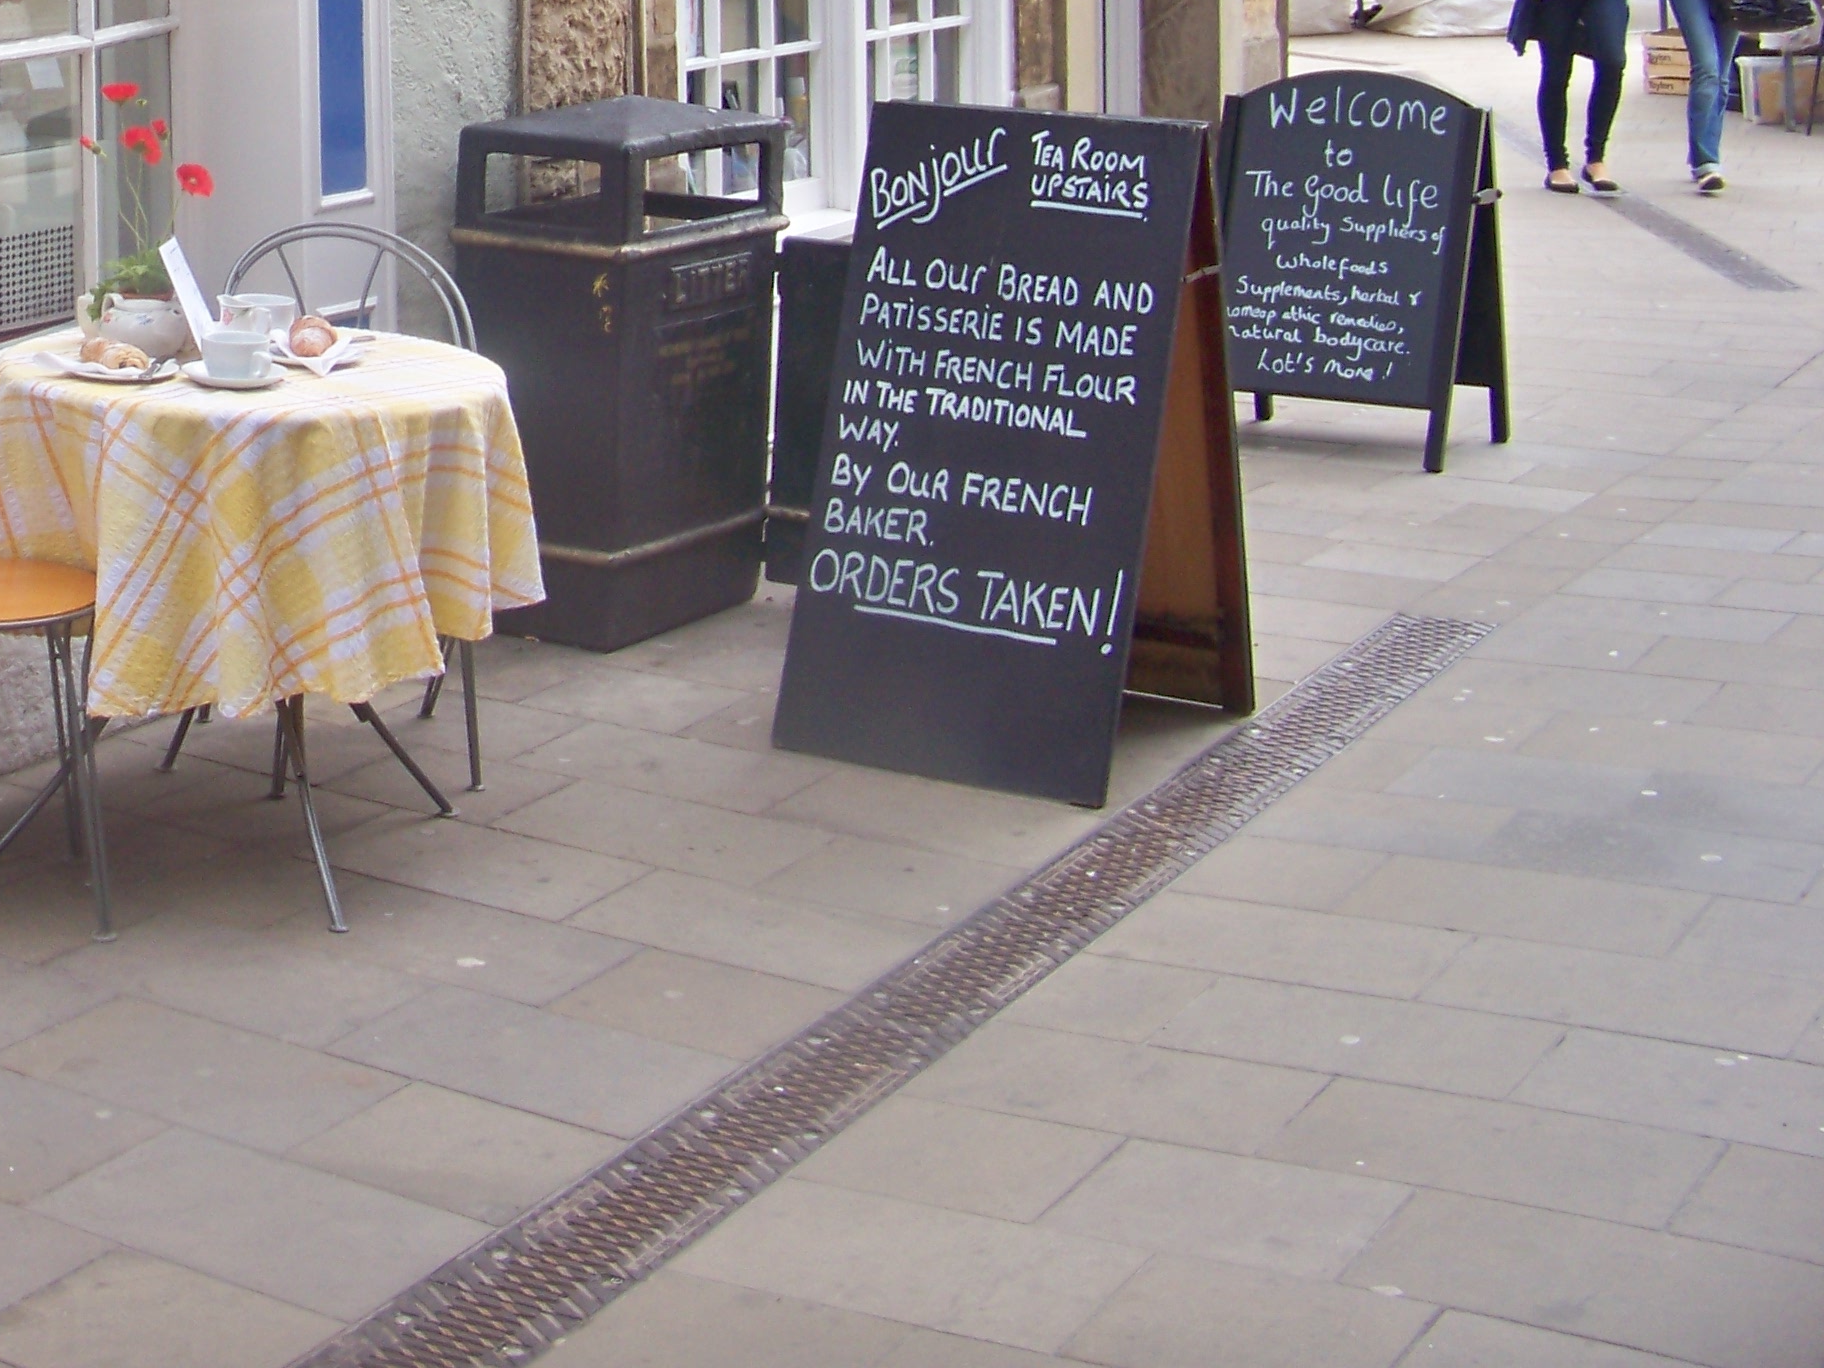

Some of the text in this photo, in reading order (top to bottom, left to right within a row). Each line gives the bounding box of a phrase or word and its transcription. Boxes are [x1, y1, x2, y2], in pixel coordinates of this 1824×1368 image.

[1269, 86, 1448, 135] Welcome
[1031, 130, 1146, 178] TEA ROOM
[1324, 139, 1353, 167] to
[1031, 173, 1149, 210] UPSTAIRS
[1245, 170, 1439, 229] The Good Life
[1261, 216, 1330, 250] quality
[1430, 225, 1446, 255] of
[675, 259, 749, 304] LITTER
[866, 245, 917, 287] ALL
[997, 263, 1078, 307] BREAD
[1094, 279, 1155, 315] AND
[859, 293, 1138, 357] PATISSERIE IS MADE
[856, 339, 1136, 405] WITH FRENCH FLOUR
[843, 380, 1087, 438] IN THE TRADITIONAL
[887, 461, 949, 502] OUR
[961, 472, 1093, 526] FRENCH
[809, 548, 960, 615] ORDERS
